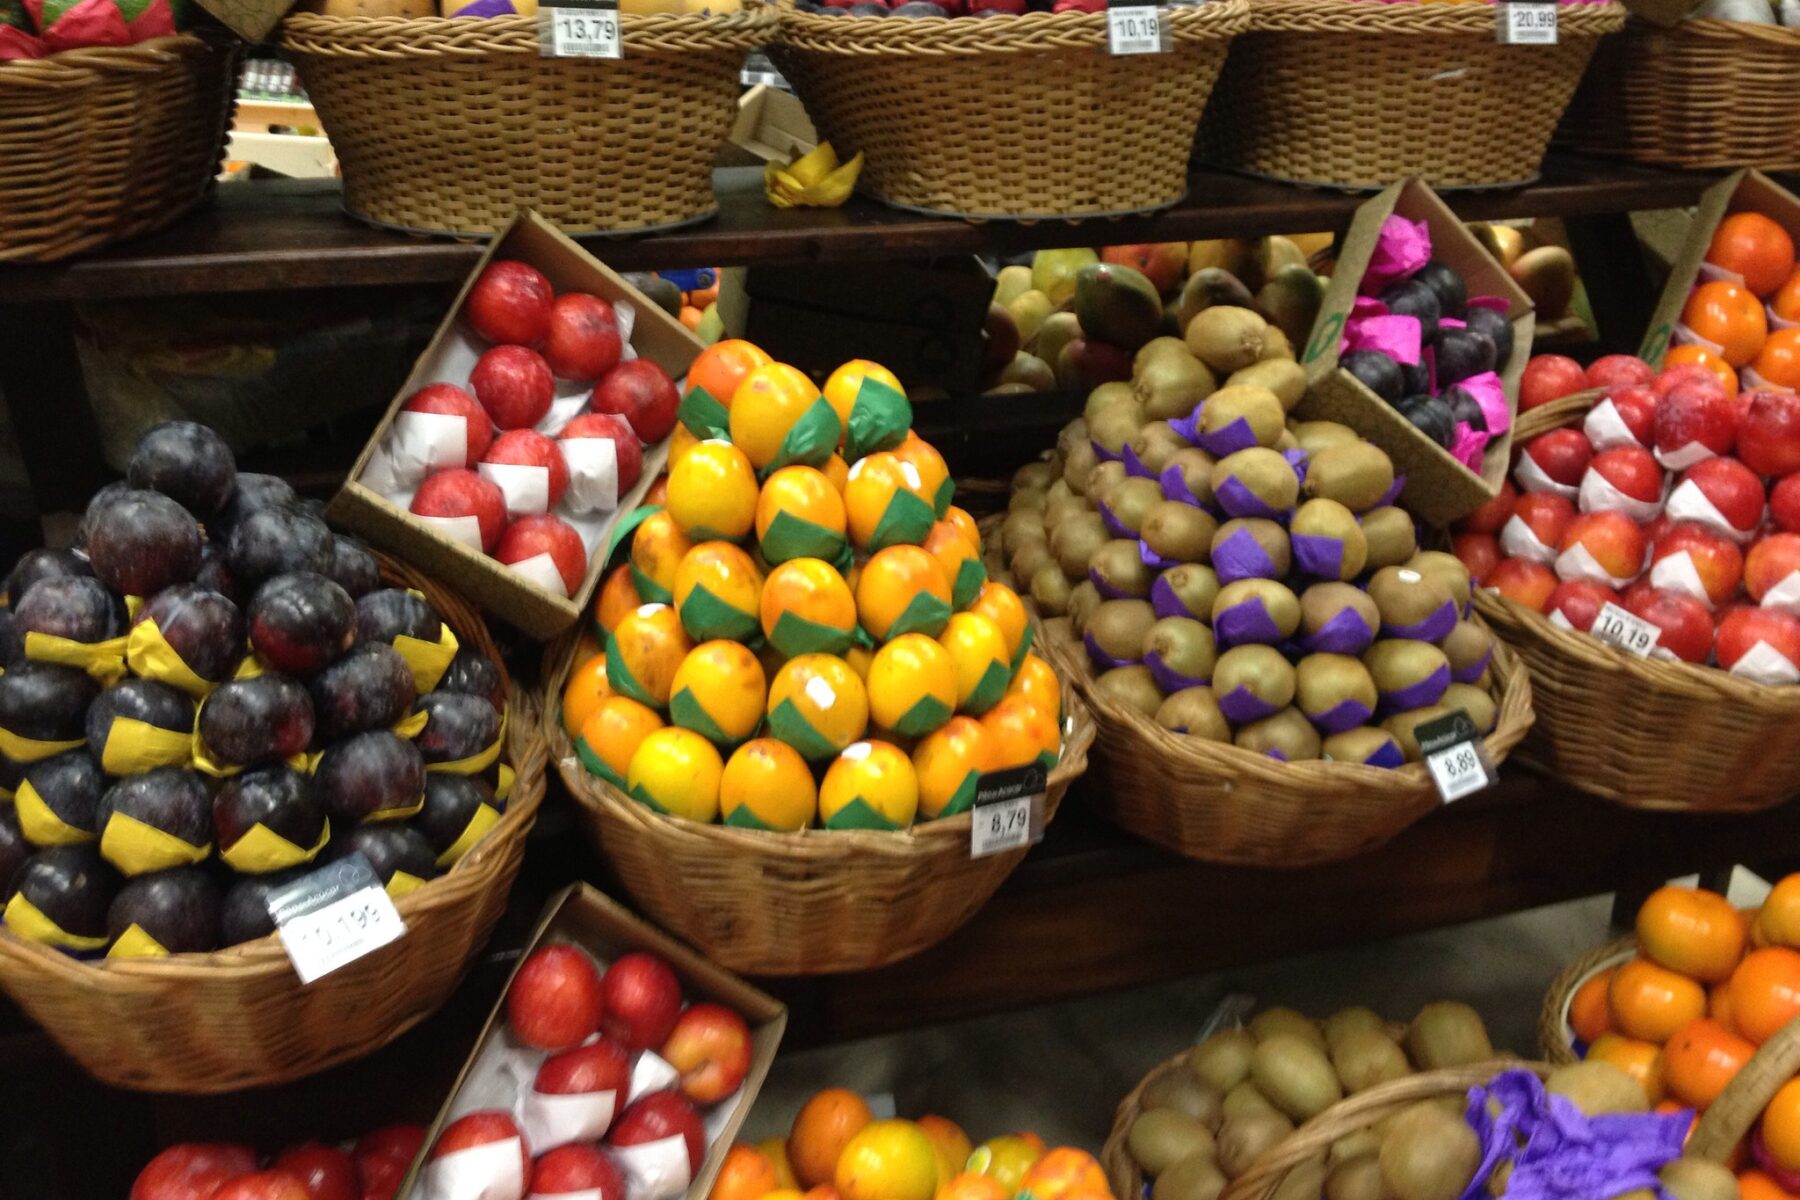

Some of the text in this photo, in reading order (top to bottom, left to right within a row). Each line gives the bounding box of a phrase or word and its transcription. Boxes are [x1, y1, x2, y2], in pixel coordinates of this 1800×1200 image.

[563, 18, 617, 41] 13,79
[1118, 18, 1159, 40] 10,19
[1603, 614, 1650, 649] 10,19
[1445, 749, 1476, 777] 8,89
[991, 806, 1027, 839] 8,79
